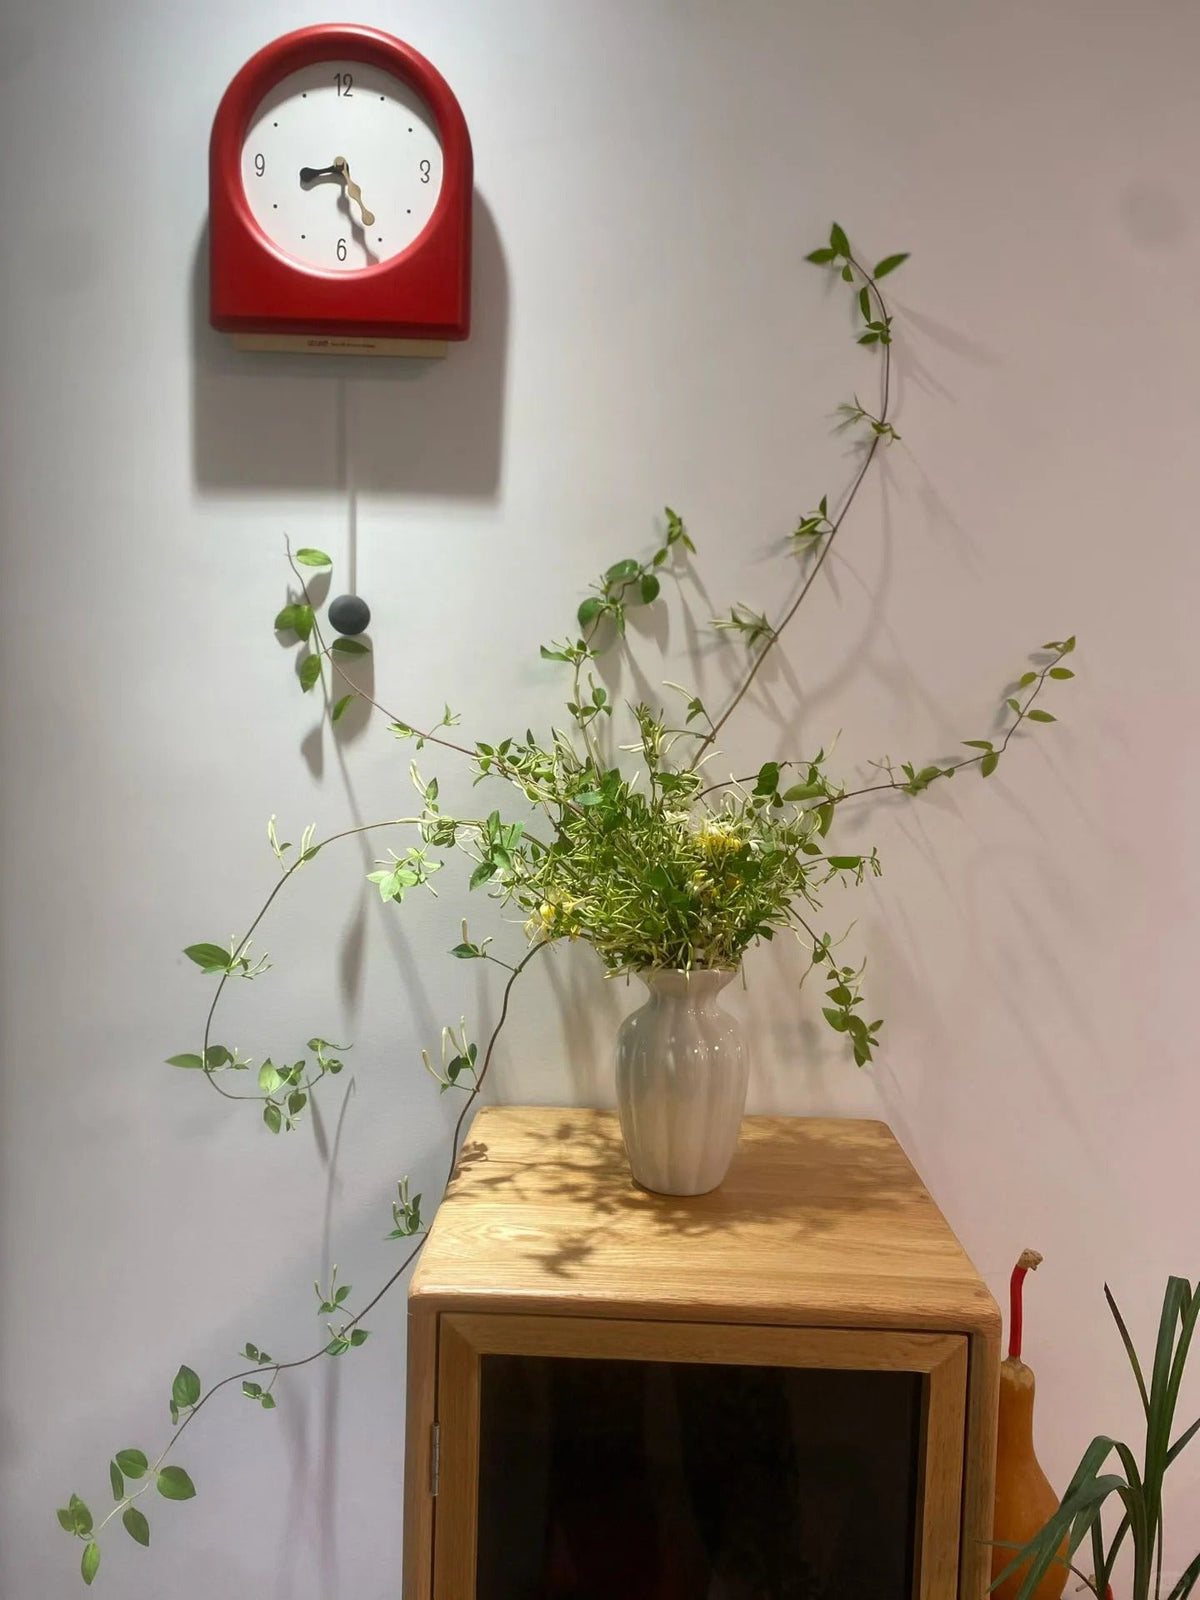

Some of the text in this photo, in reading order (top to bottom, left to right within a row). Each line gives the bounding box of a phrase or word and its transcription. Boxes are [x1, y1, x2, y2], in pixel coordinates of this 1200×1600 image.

[333, 72, 354, 97] 12
[254, 153, 266, 178] 9
[419, 159, 431, 184] 3
[336, 238, 347, 262] 6
